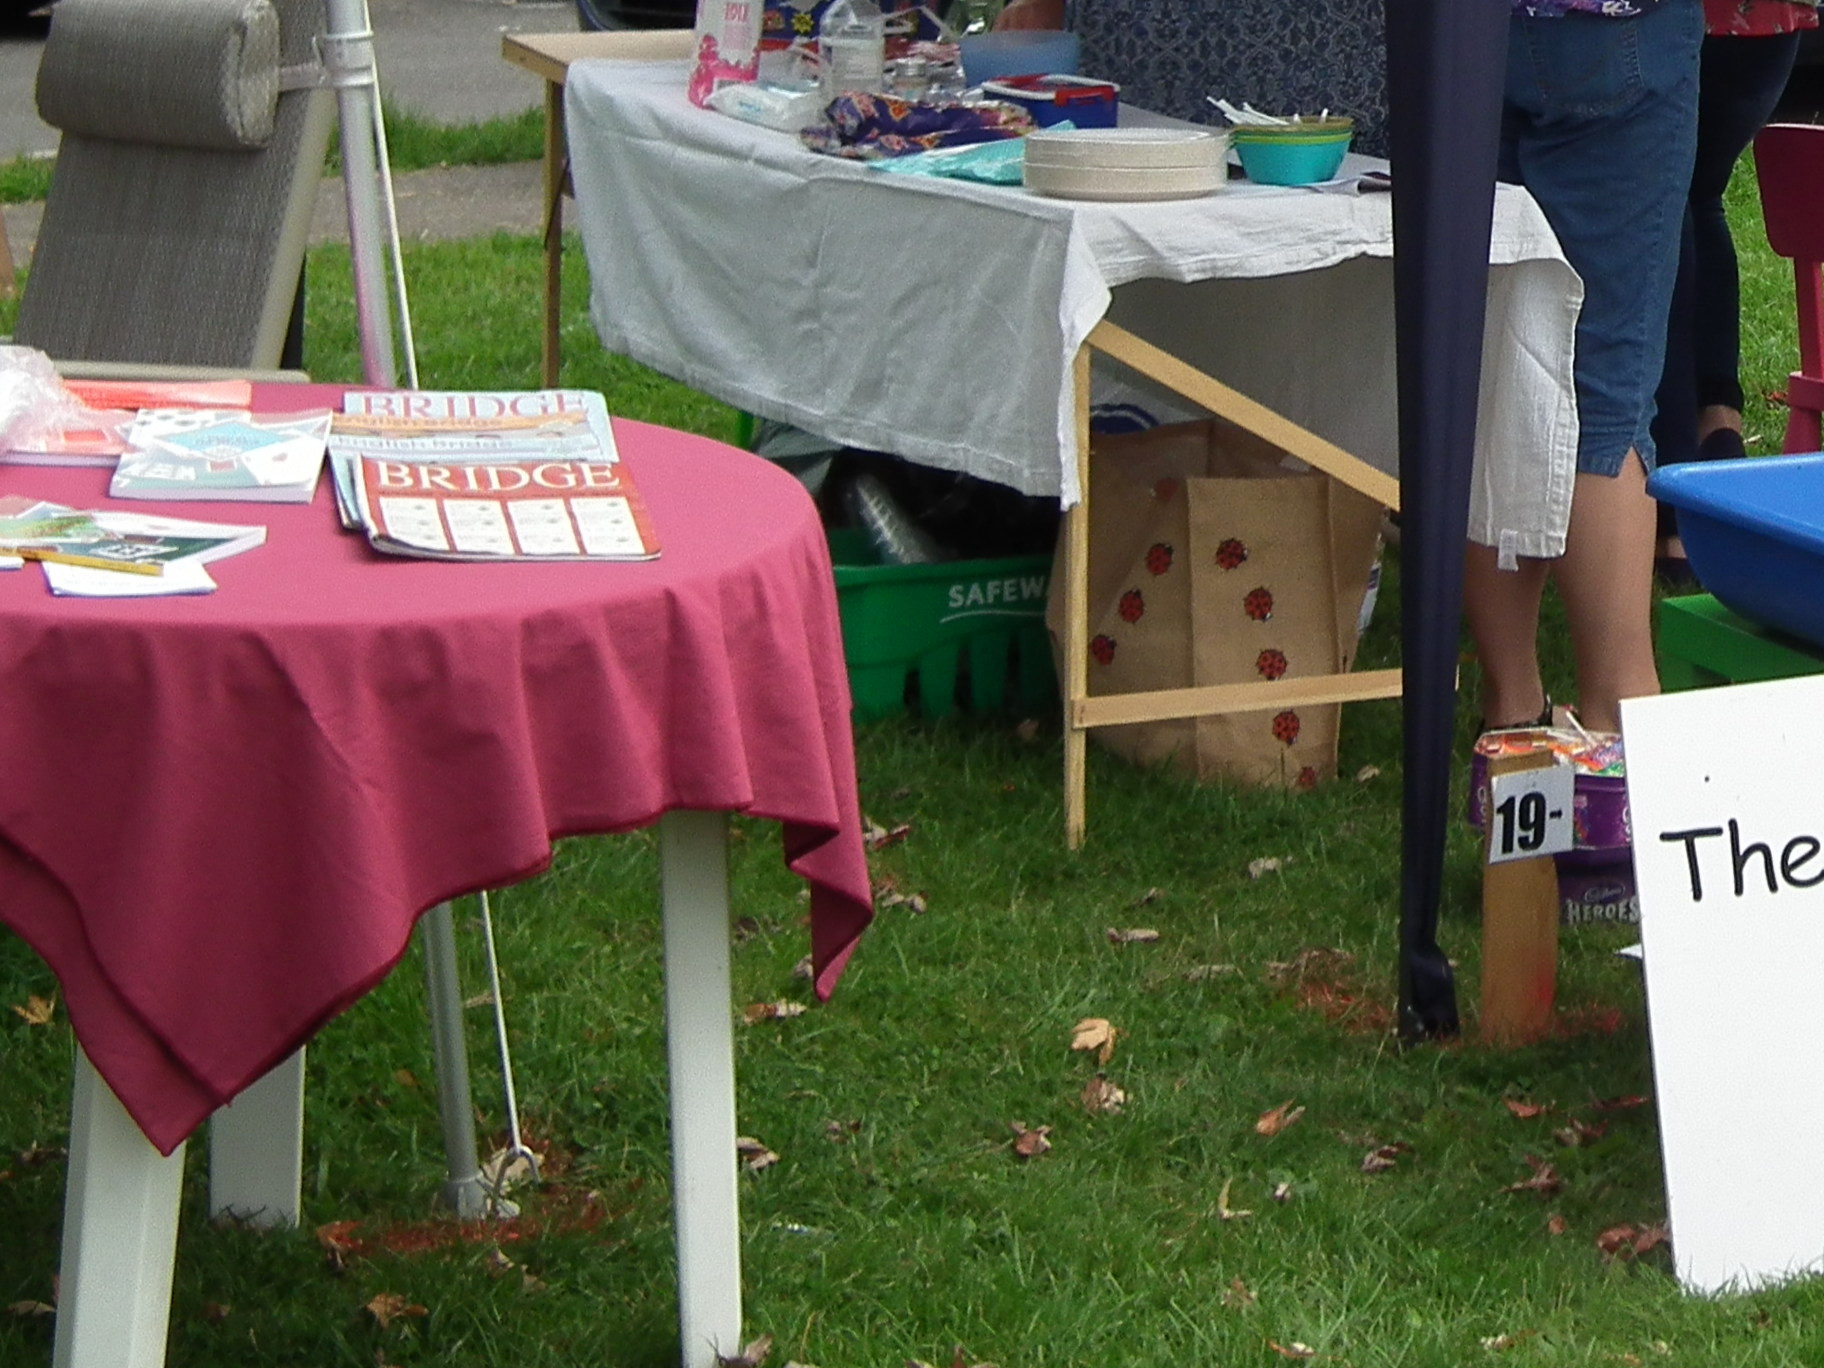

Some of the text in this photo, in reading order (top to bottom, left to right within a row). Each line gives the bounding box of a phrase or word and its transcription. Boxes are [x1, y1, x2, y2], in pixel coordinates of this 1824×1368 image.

[363, 393, 586, 418] BRIDGE
[377, 462, 620, 490] BRIDGE
[949, 574, 1048, 610] SAFEW
[1567, 898, 1641, 925] HEROES
